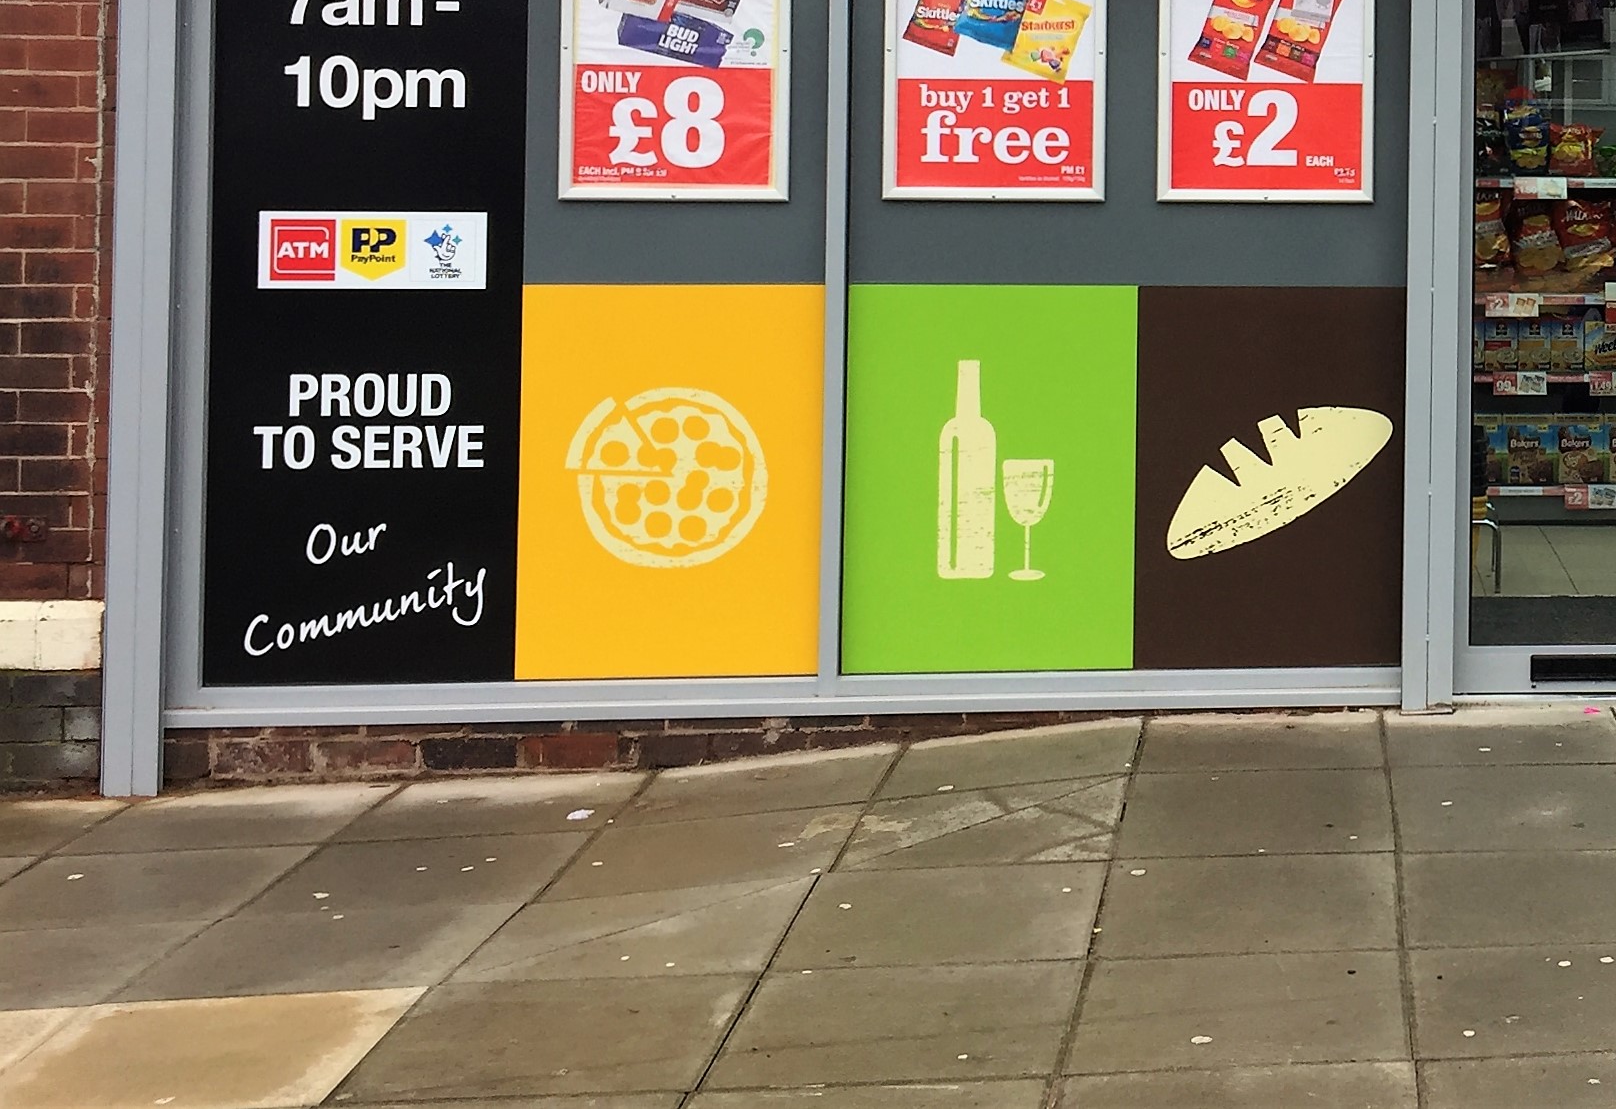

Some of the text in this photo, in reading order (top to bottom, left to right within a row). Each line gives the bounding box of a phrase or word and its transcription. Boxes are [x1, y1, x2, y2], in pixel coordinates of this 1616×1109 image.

[667, 24, 699, 42] BUD
[1022, 20, 1074, 31] Starburst
[658, 34, 698, 56] LIGHT
[284, 55, 466, 120] 10pm
[581, 70, 642, 93] ONLY
[920, 84, 1070, 114] buy 1 get 1
[1188, 90, 1245, 111] ONLY
[608, 76, 726, 168] £8
[1212, 90, 1298, 168] £2
[920, 110, 1070, 164] free
[578, 166, 601, 176] EACH
[1306, 156, 1334, 167] EACH
[277, 242, 329, 258] ATM
[351, 254, 396, 264] PayPoint
[289, 372, 451, 417] PROUD
[253, 425, 485, 470] TO SERVE
[1510, 439, 1539, 448] Bakers
[1561, 439, 1590, 448] Bakers
[306, 523, 387, 565] Our
[244, 562, 486, 656] Community
